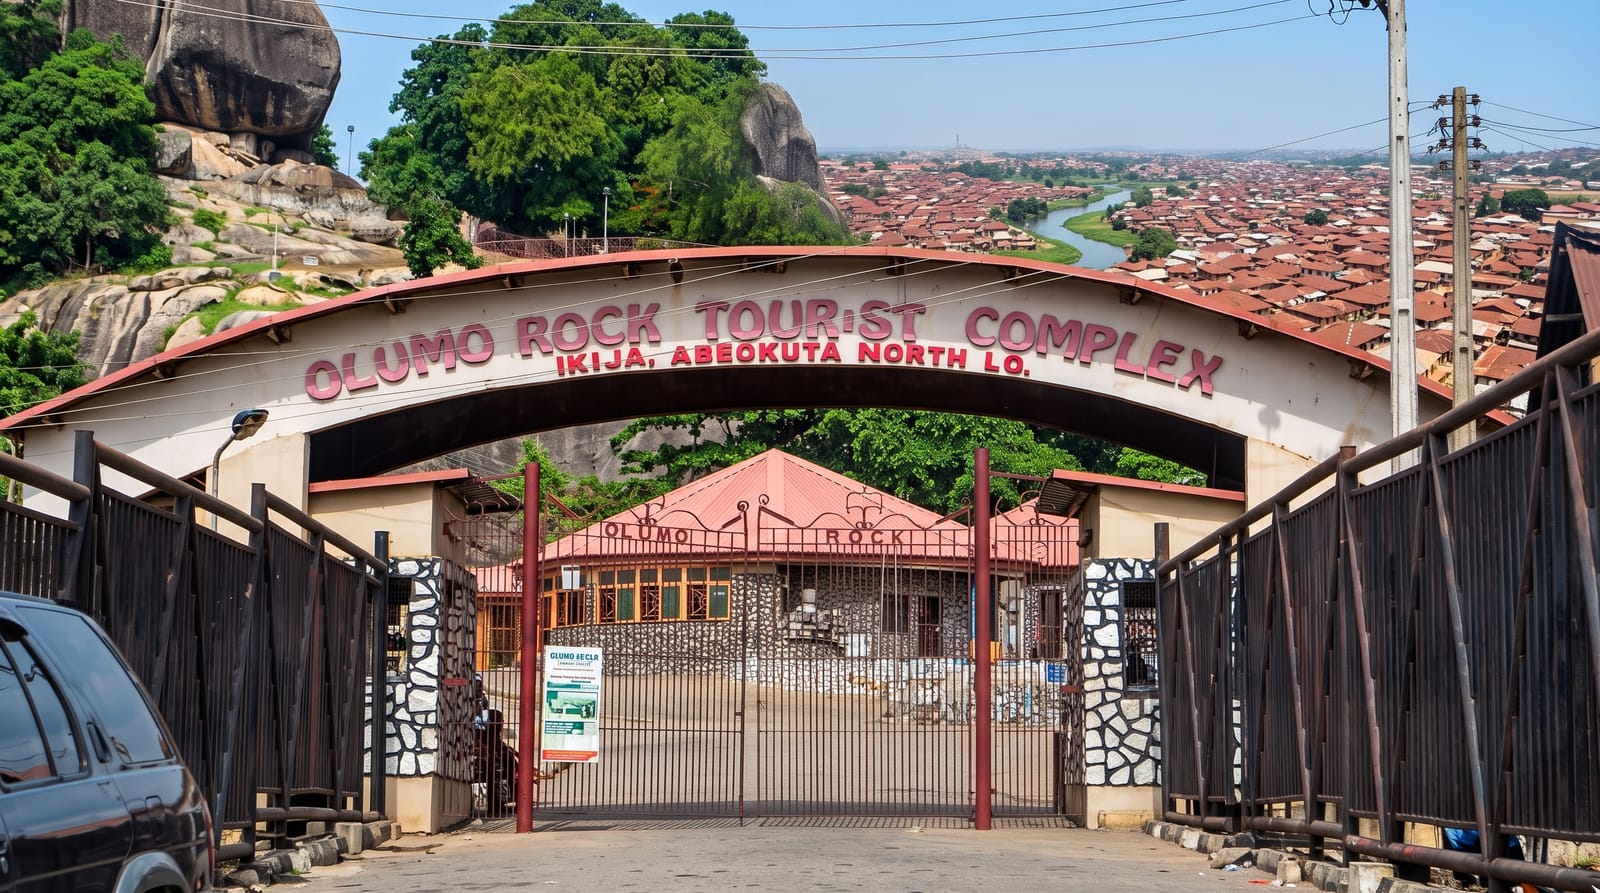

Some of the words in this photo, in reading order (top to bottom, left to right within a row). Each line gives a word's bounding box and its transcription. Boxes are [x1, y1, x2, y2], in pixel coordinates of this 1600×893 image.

[305, 323, 494, 400] OLUMO
[516, 302, 661, 357] ROCK
[966, 307, 1224, 396] COMPLEX
[557, 347, 655, 376] IKIJA,
[671, 341, 841, 364] ABEOKUTA
[858, 341, 967, 367] NORTH
[983, 351, 1031, 376] LO.
[604, 521, 689, 545] OLUMO
[825, 529, 904, 545] ROCK
